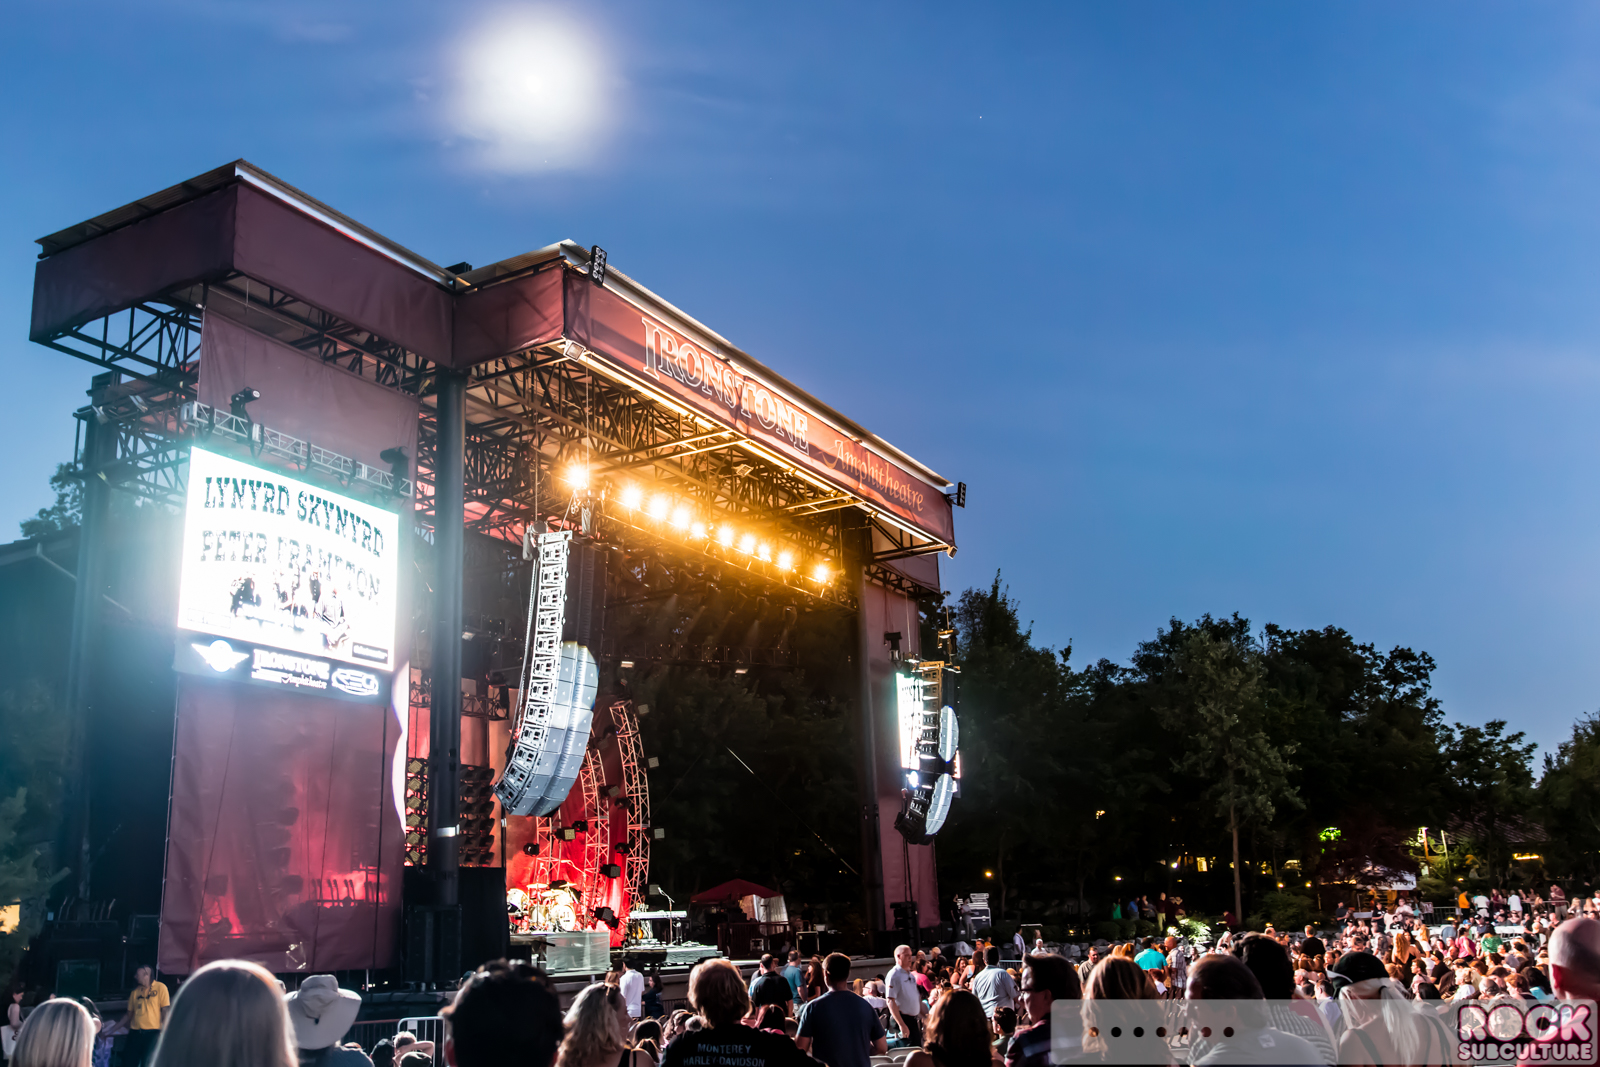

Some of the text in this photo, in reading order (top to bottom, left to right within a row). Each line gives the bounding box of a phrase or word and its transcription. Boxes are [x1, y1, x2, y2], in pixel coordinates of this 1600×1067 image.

[641, 316, 924, 512] IRONSTONE Amphitheatre
[204, 476, 384, 558] LYNYRD SKYNYRD
[200, 530, 268, 564] PETER
[697, 1043, 752, 1055] MONTEREY
